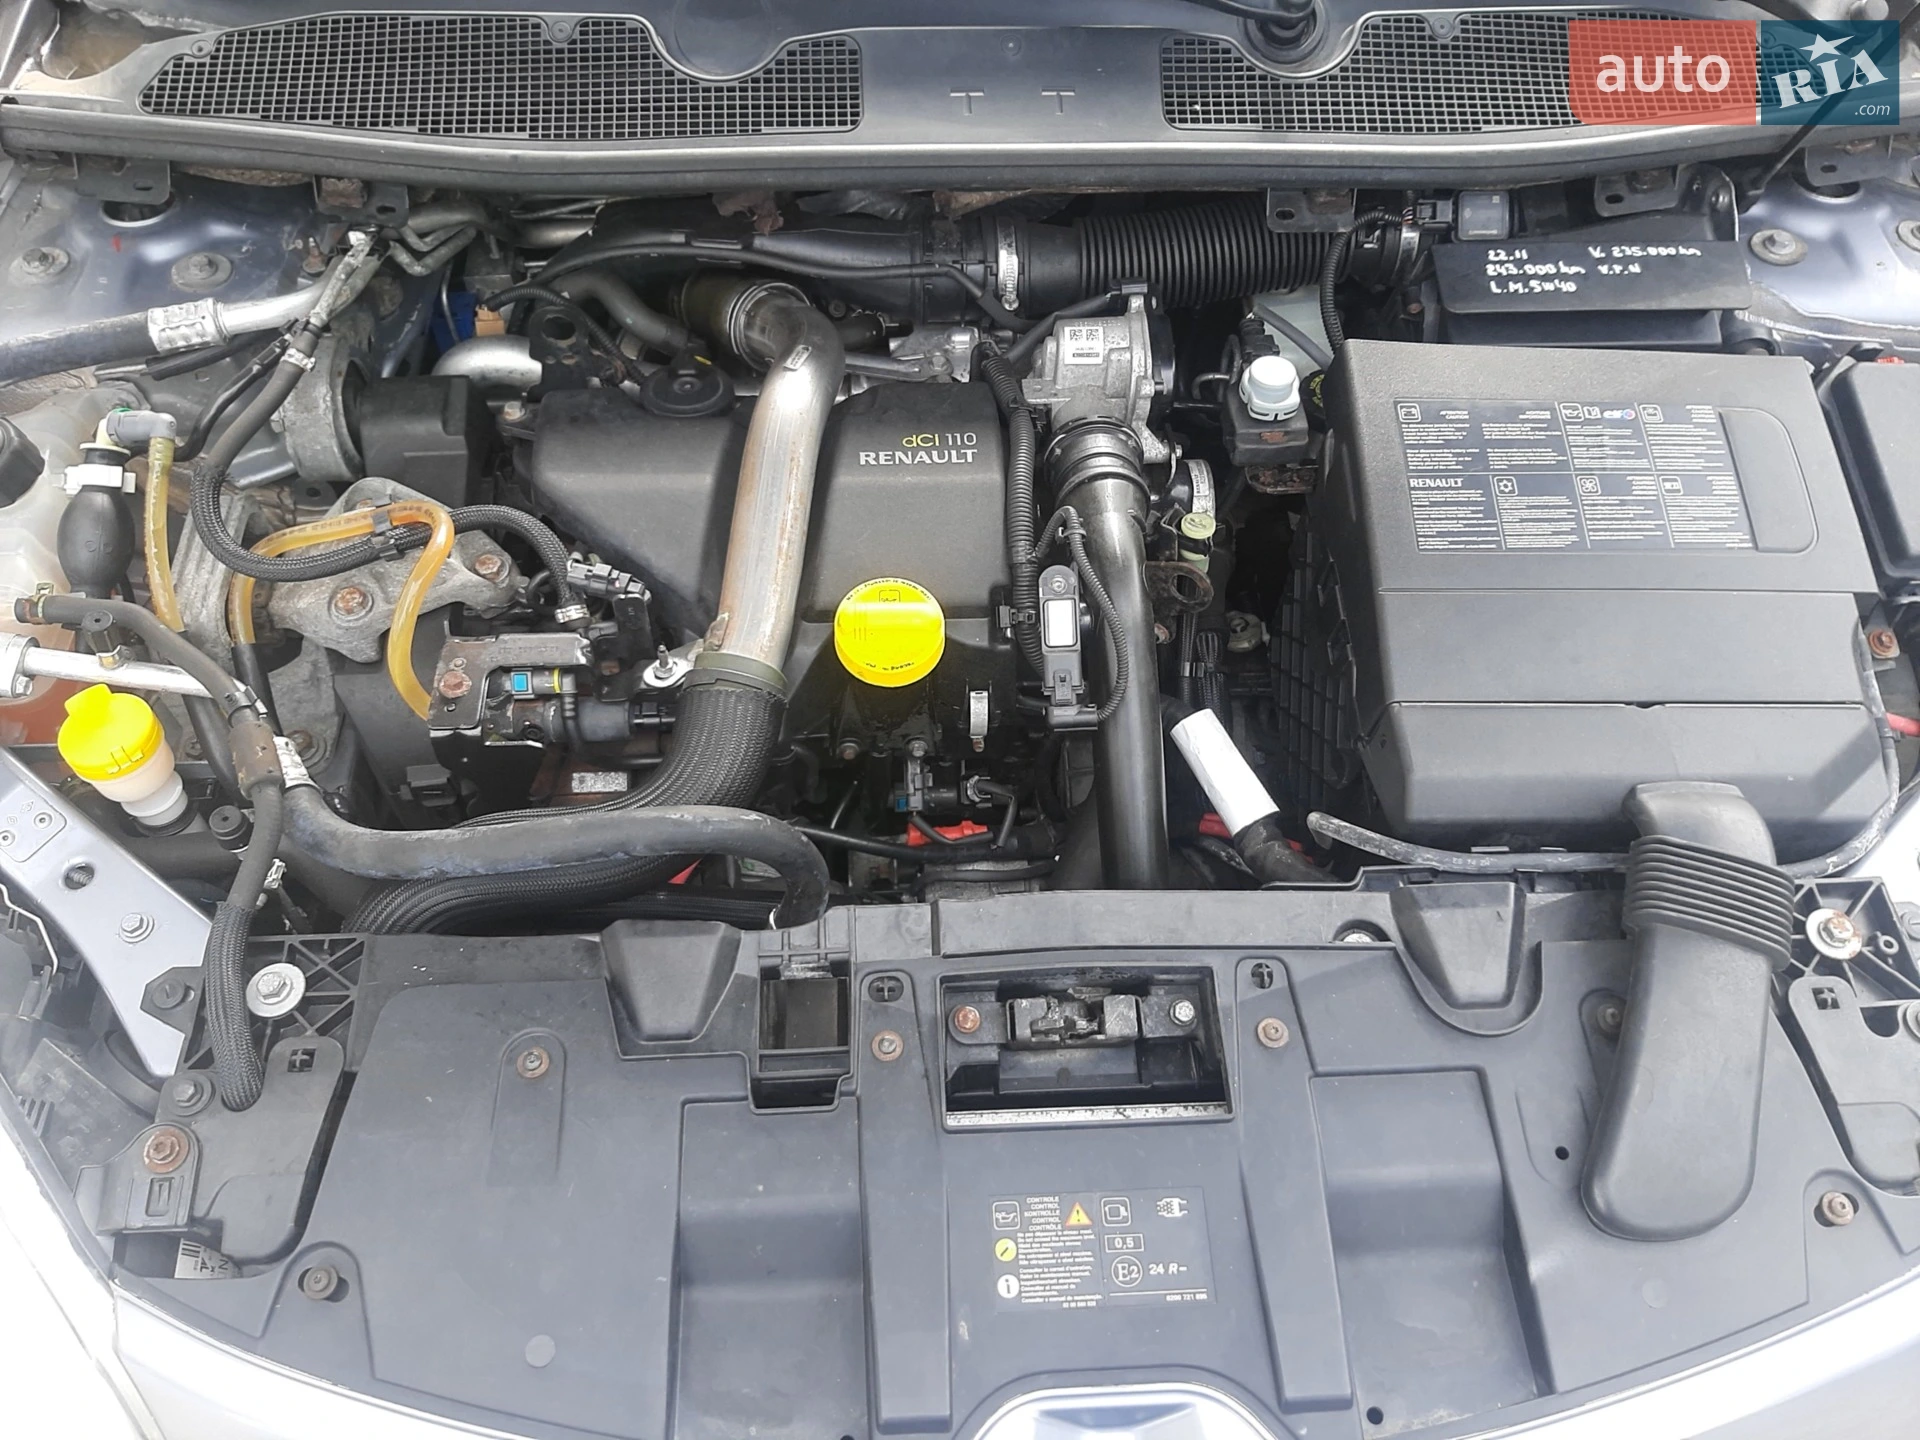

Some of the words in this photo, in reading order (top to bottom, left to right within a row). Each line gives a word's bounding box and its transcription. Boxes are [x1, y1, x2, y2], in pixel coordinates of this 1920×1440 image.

[945, 432, 976, 446] 110
[859, 449, 978, 465] RENAULT
[1409, 478, 1463, 488] RENAULT
[1115, 1237, 1134, 1249] 0,5
[1116, 1263, 1139, 1281] E2
[1148, 1263, 1165, 1275] 24
